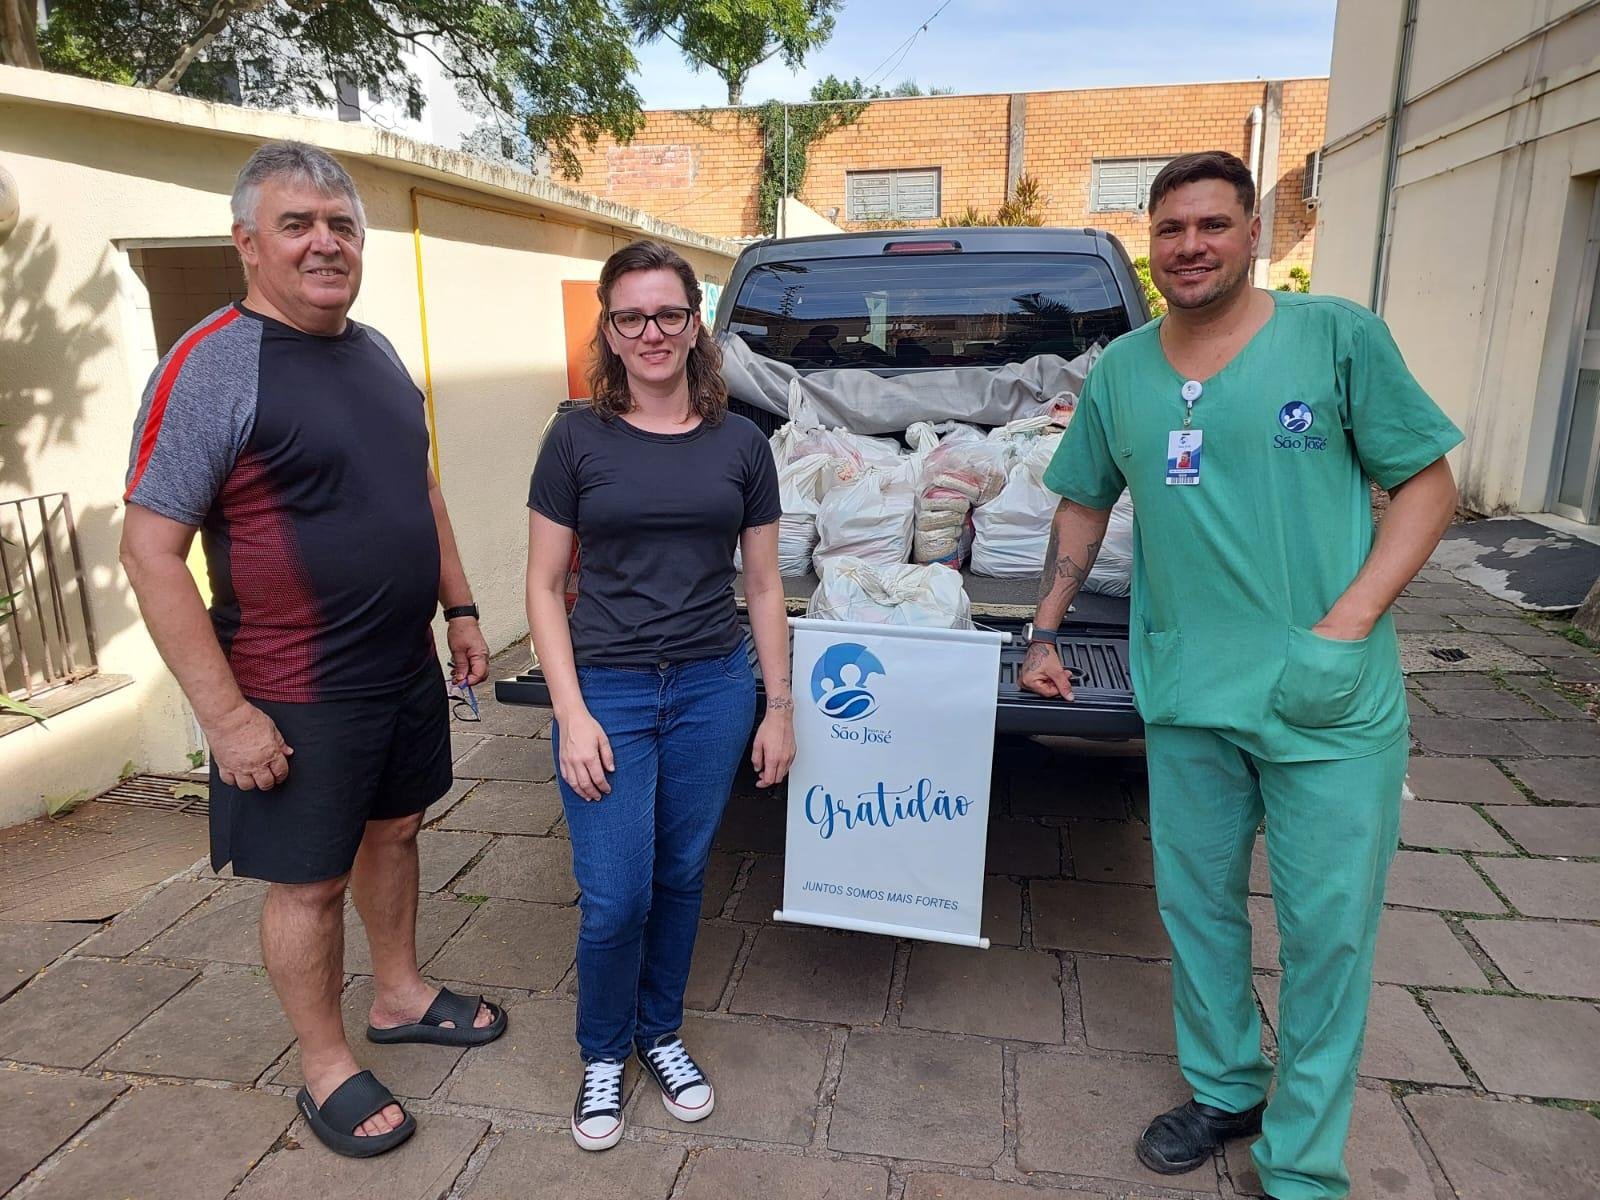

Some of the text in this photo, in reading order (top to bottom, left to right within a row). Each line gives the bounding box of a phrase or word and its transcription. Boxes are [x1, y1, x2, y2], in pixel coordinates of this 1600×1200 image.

[1273, 434, 1328, 452] São José
[830, 723, 892, 745] São José
[805, 778, 974, 839] Gratidão
[802, 880, 959, 911] JUNTOS SOMOS MAIS FORTES
